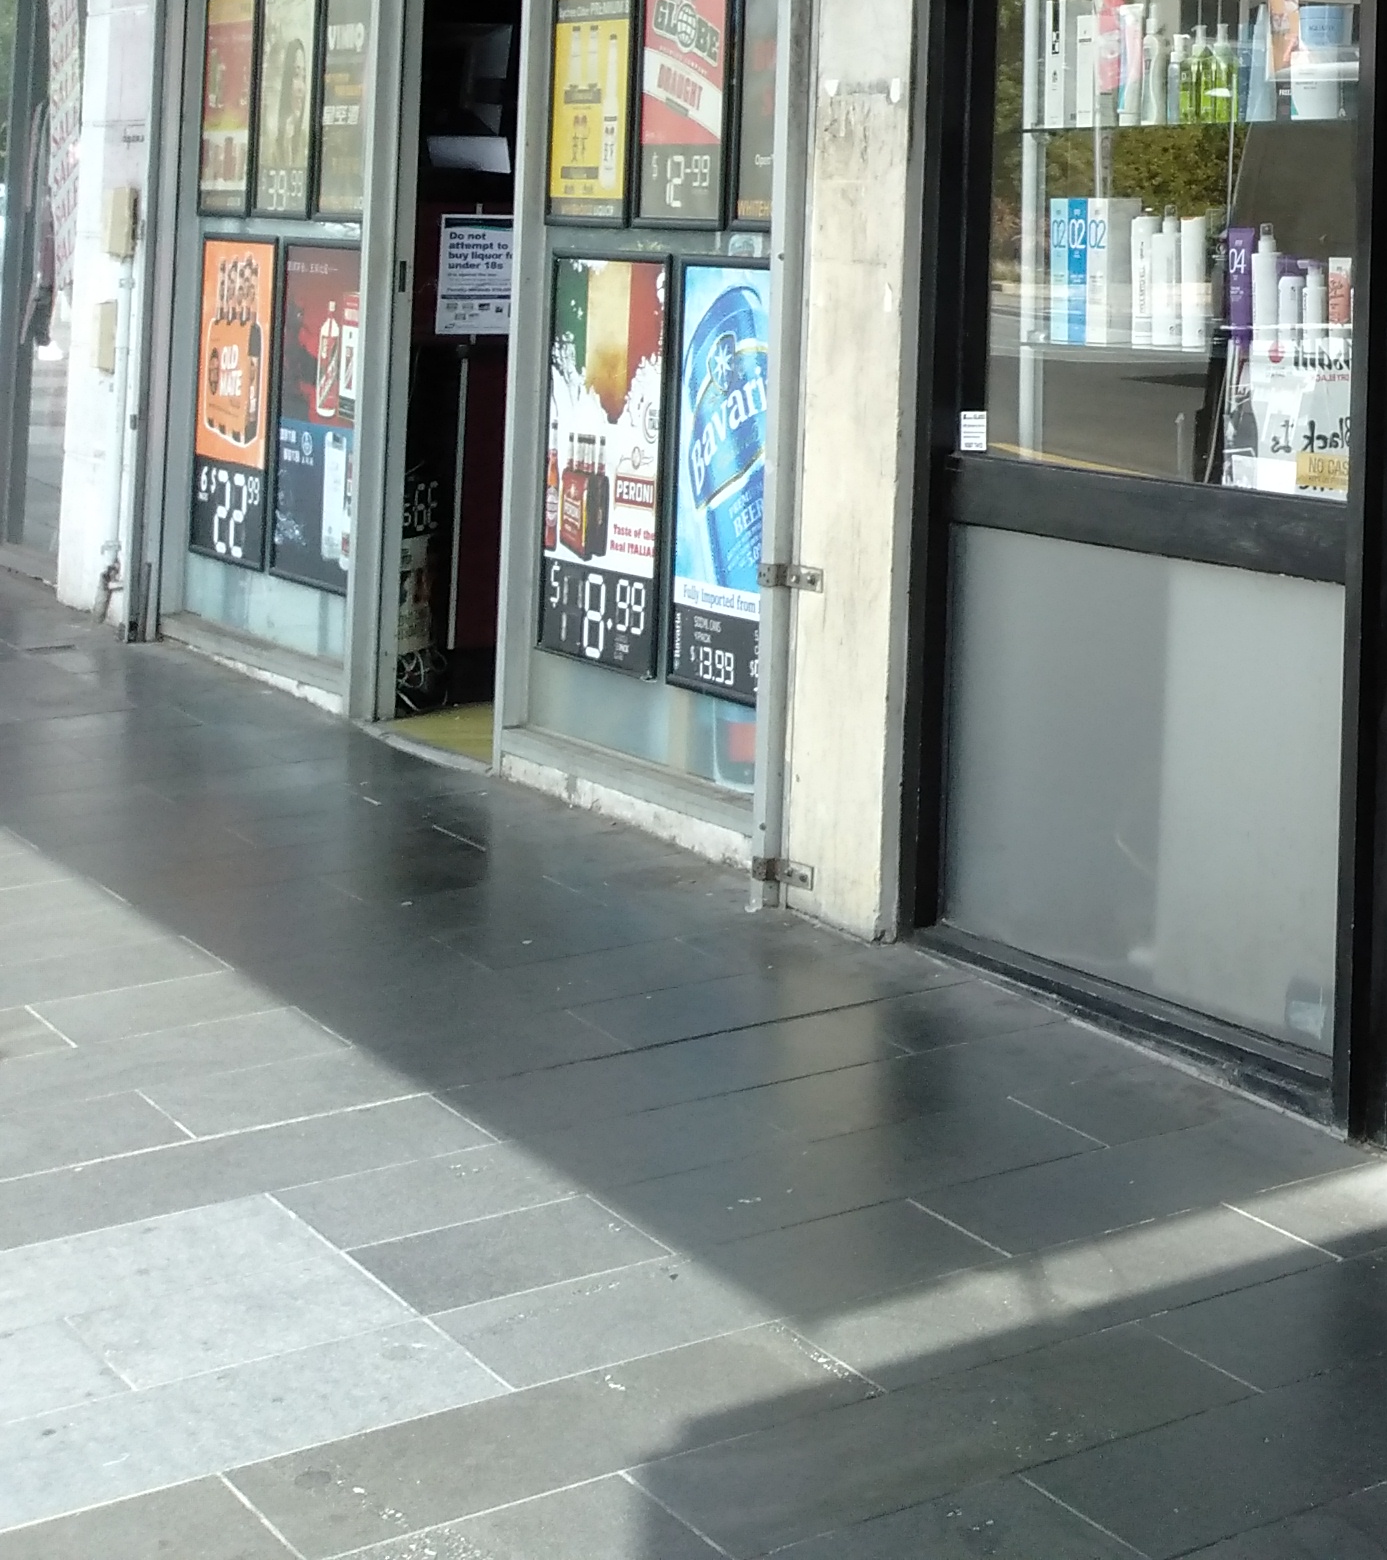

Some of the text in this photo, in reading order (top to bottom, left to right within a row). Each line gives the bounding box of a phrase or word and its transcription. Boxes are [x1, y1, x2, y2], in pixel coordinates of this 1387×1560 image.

[737, 200, 772, 217] WHITEH
[449, 232, 486, 240] Do not
[1053, 219, 1066, 249] 02
[1069, 219, 1086, 249] 02
[1089, 219, 1106, 249] 02
[448, 242, 509, 251] attempt to
[448, 252, 468, 260] buy
[471, 251, 502, 260] liquor
[448, 262, 504, 270] under 18s
[1229, 248, 1246, 274] 04
[220, 344, 239, 370] OLD
[219, 370, 243, 396] MATE
[691, 366, 768, 495] Bavari
[1309, 456, 1349, 476] NO CAS
[616, 480, 653, 504] PERONI
[613, 524, 632, 537] Taste
[610, 540, 626, 552] Real
[702, 586, 735, 610] Imported
[737, 594, 756, 614] from
